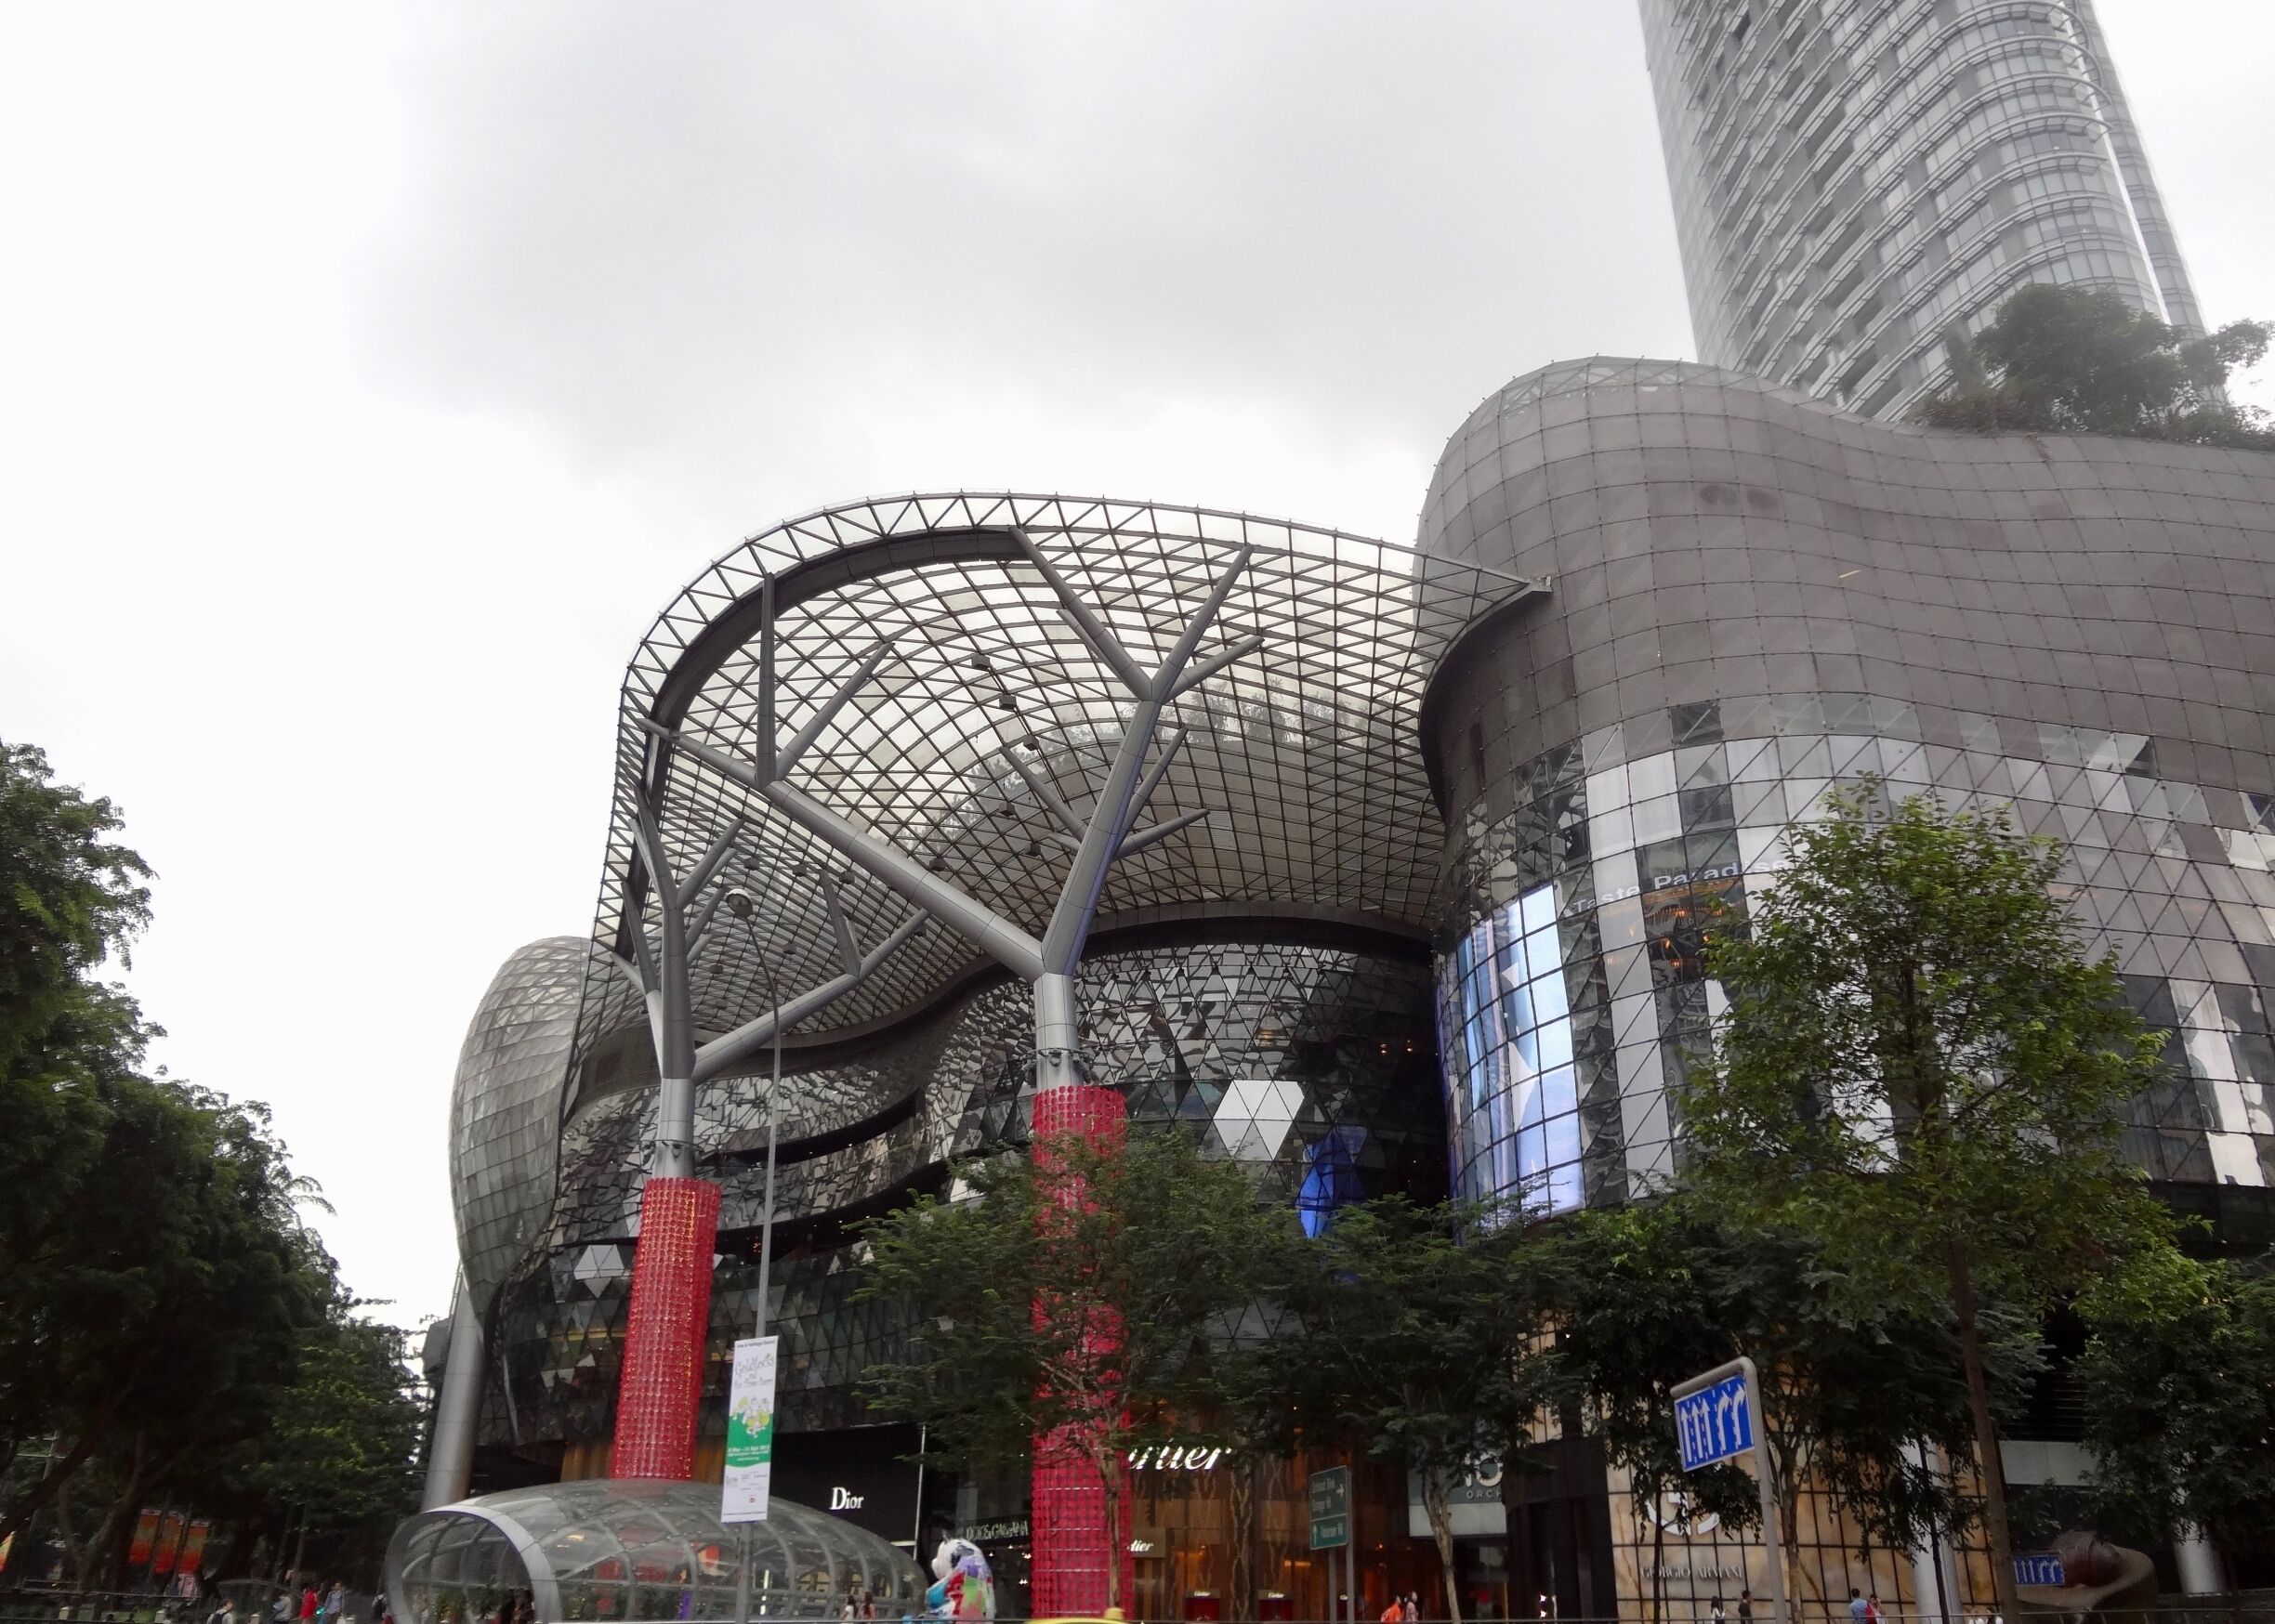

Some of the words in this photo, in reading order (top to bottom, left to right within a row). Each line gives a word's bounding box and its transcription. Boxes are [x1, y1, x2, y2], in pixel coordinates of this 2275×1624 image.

[1573, 885, 1640, 912] Taste
[829, 1486, 864, 1510] Dior
[1698, 1565, 1743, 1578] ARMANI
